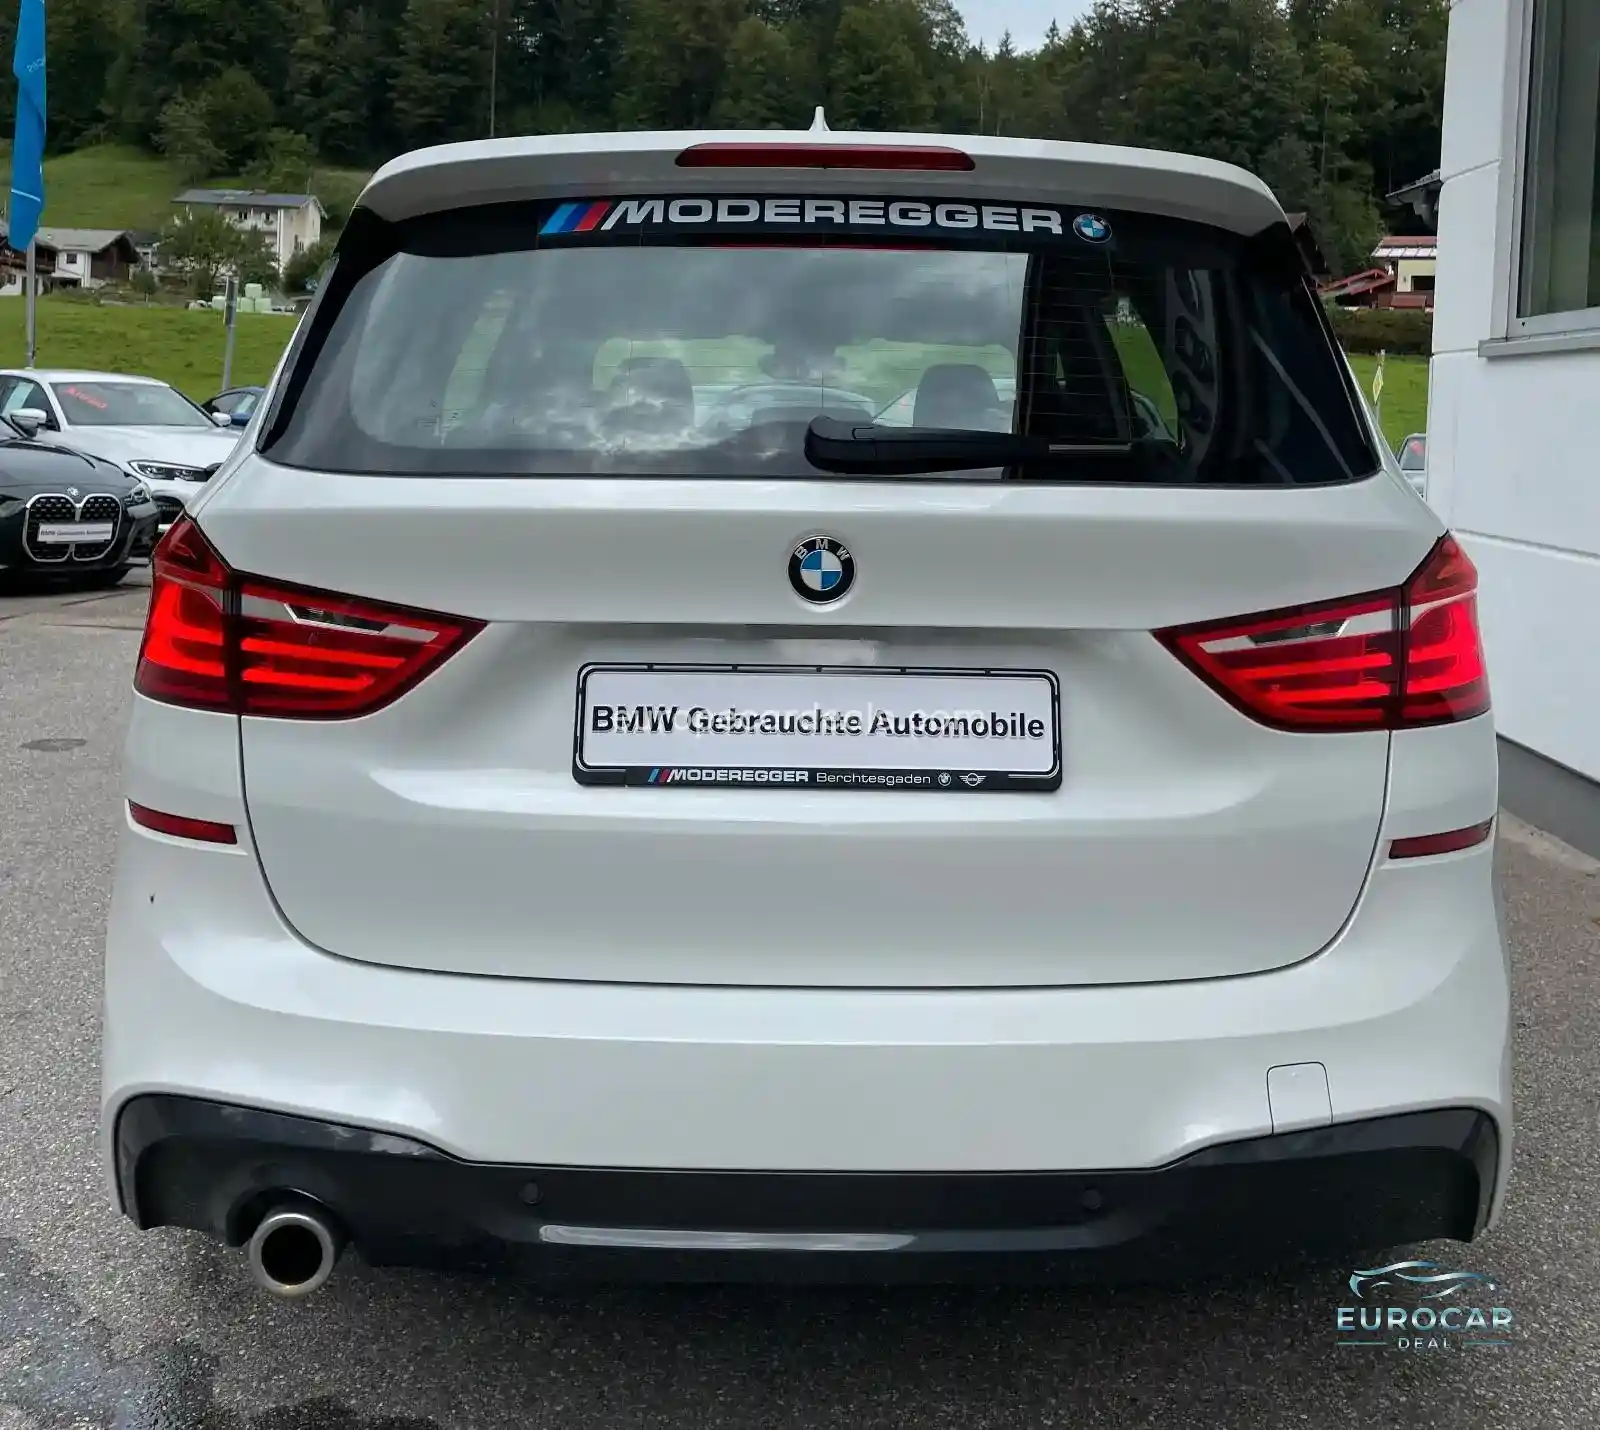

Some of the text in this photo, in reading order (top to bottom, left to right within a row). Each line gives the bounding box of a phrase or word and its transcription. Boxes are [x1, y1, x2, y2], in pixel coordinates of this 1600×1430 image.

[601, 198, 1063, 235] MODEREGGER
[794, 538, 851, 561] BMW
[590, 704, 1045, 738] BMW Gebrauchte Automobile
[666, 768, 931, 786] MODEREGGER Berchtesgaden
